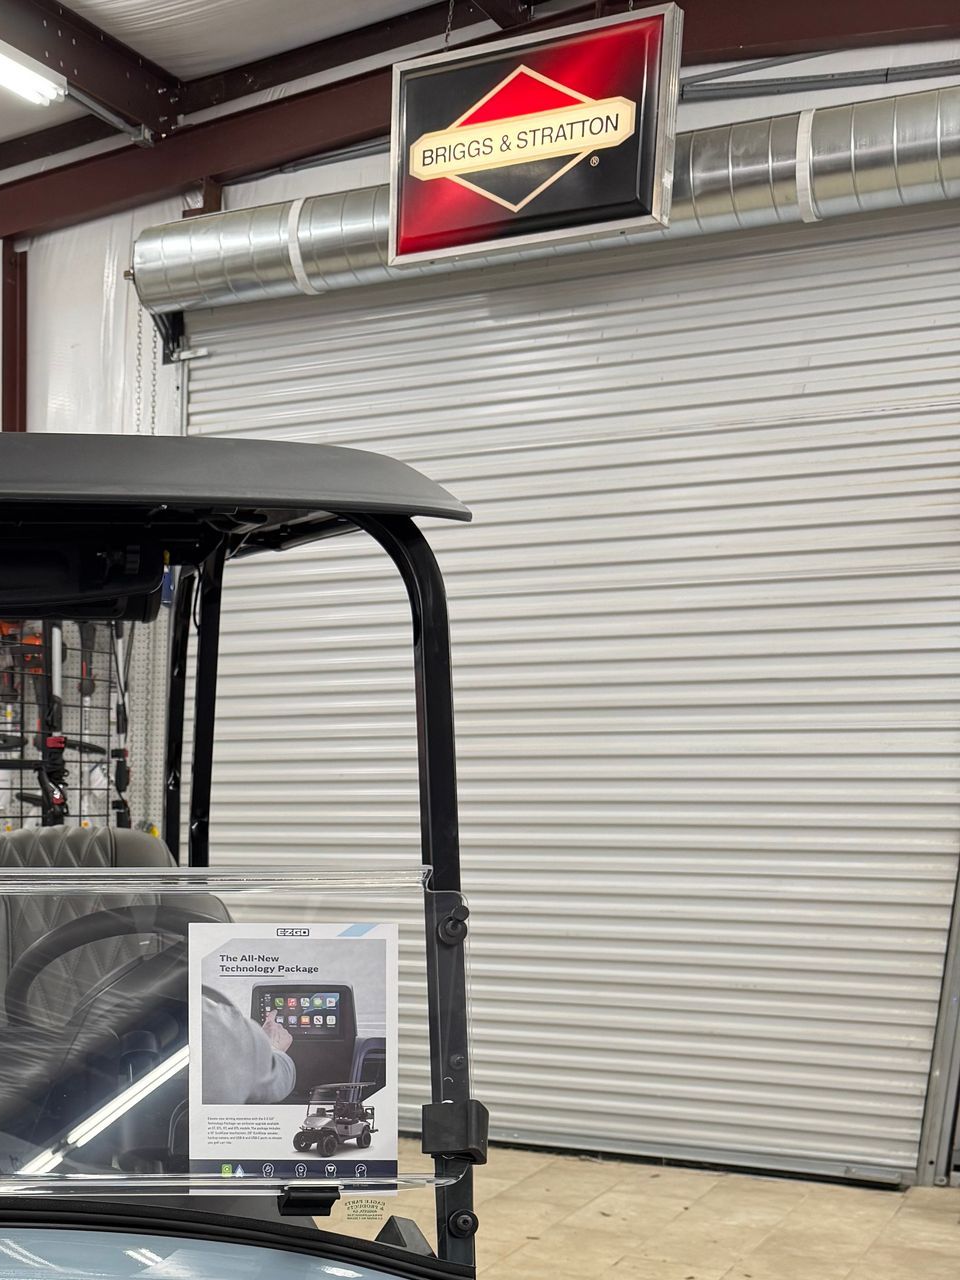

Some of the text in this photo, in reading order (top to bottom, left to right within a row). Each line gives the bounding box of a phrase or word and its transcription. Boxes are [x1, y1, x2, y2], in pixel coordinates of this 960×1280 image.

[422, 113, 619, 167] BRIGGS & STRATTON
[220, 965, 319, 973] Technology Package
